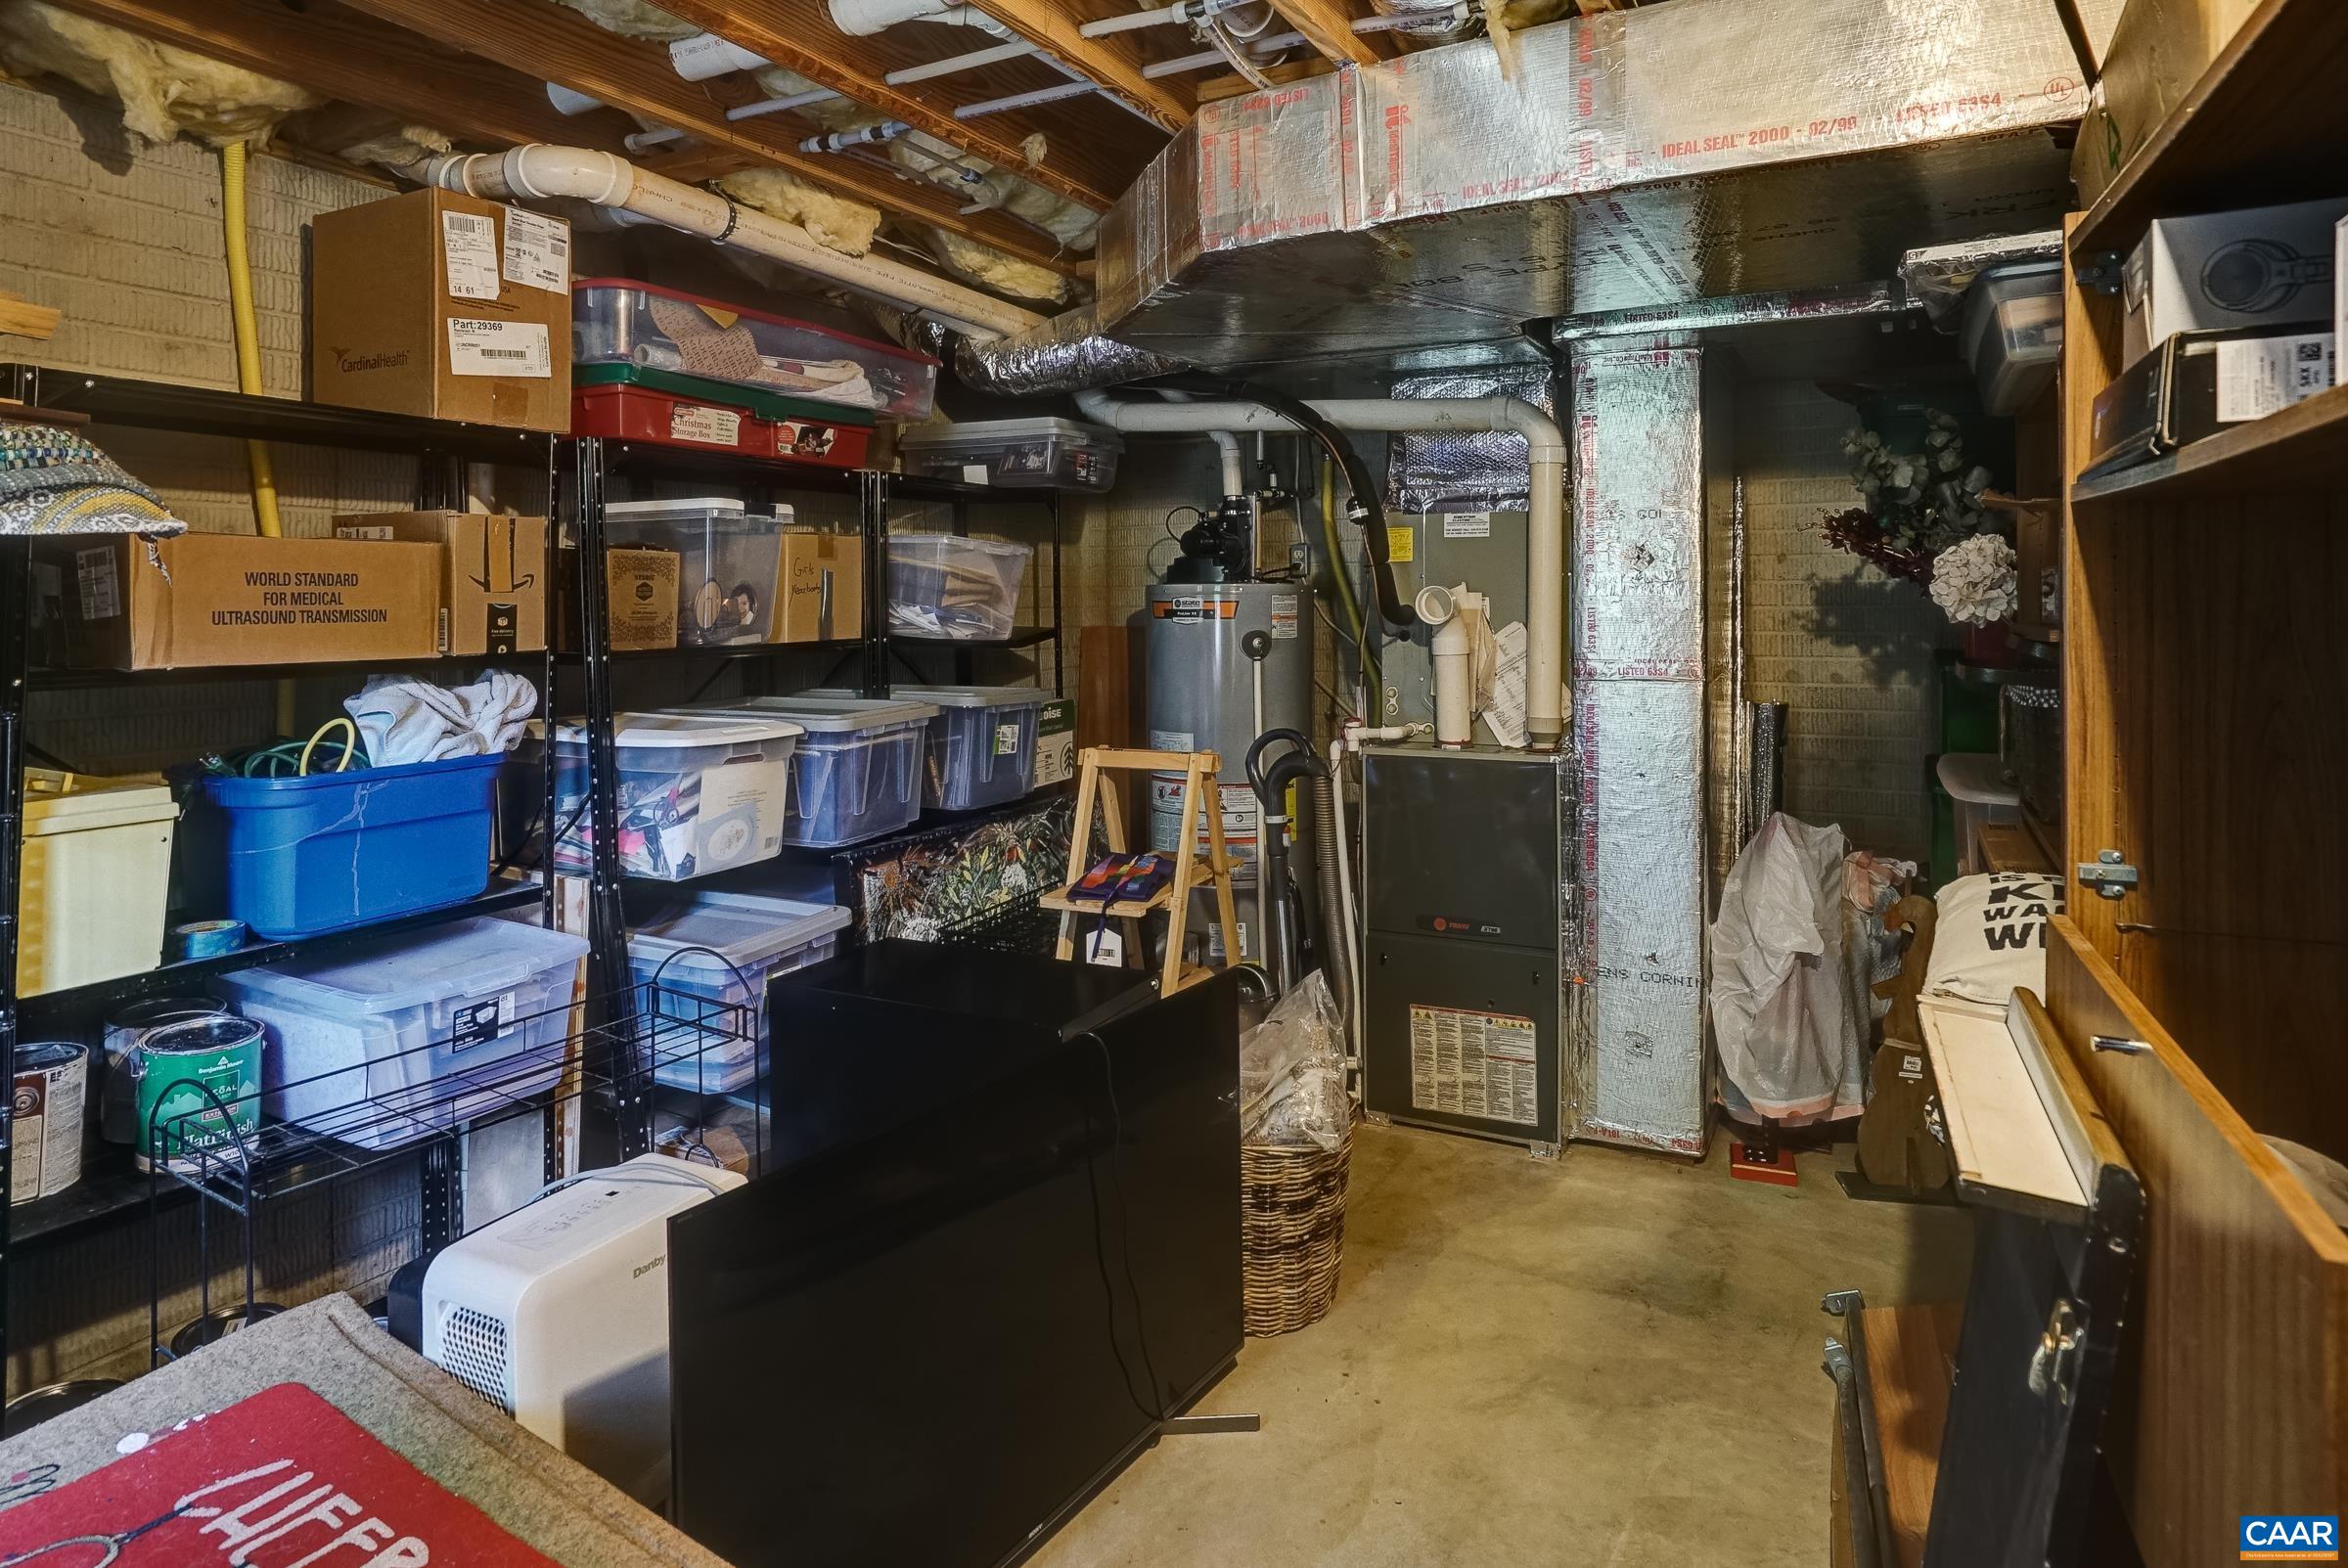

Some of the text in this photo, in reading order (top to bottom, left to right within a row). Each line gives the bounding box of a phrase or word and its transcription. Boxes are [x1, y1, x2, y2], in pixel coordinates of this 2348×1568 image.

[1578, 77, 1593, 117] 02/99
[1662, 139, 1700, 158] IDEAL
[1748, 124, 1789, 146] 2000
[1808, 115, 1858, 137] 02/99
[453, 285, 474, 294] 14 61
[453, 319, 503, 332] Part:29369
[341, 351, 408, 373] CardinalHealth
[674, 415, 712, 430] Christmas
[672, 426, 711, 439] Storage Box
[1585, 534, 1596, 555] 2000
[245, 571, 359, 587] WORLD STANDARD
[263, 591, 344, 606] FOR MEDICAL
[211, 608, 387, 626] ULTRASOUND TRANSMISSION
[1617, 667, 1645, 676] LISTED
[1648, 667, 1669, 676] 63S4
[1596, 966, 1629, 980] ENS
[199, 1065, 226, 1075] Benjamin
[633, 1253, 666, 1279] Danby
